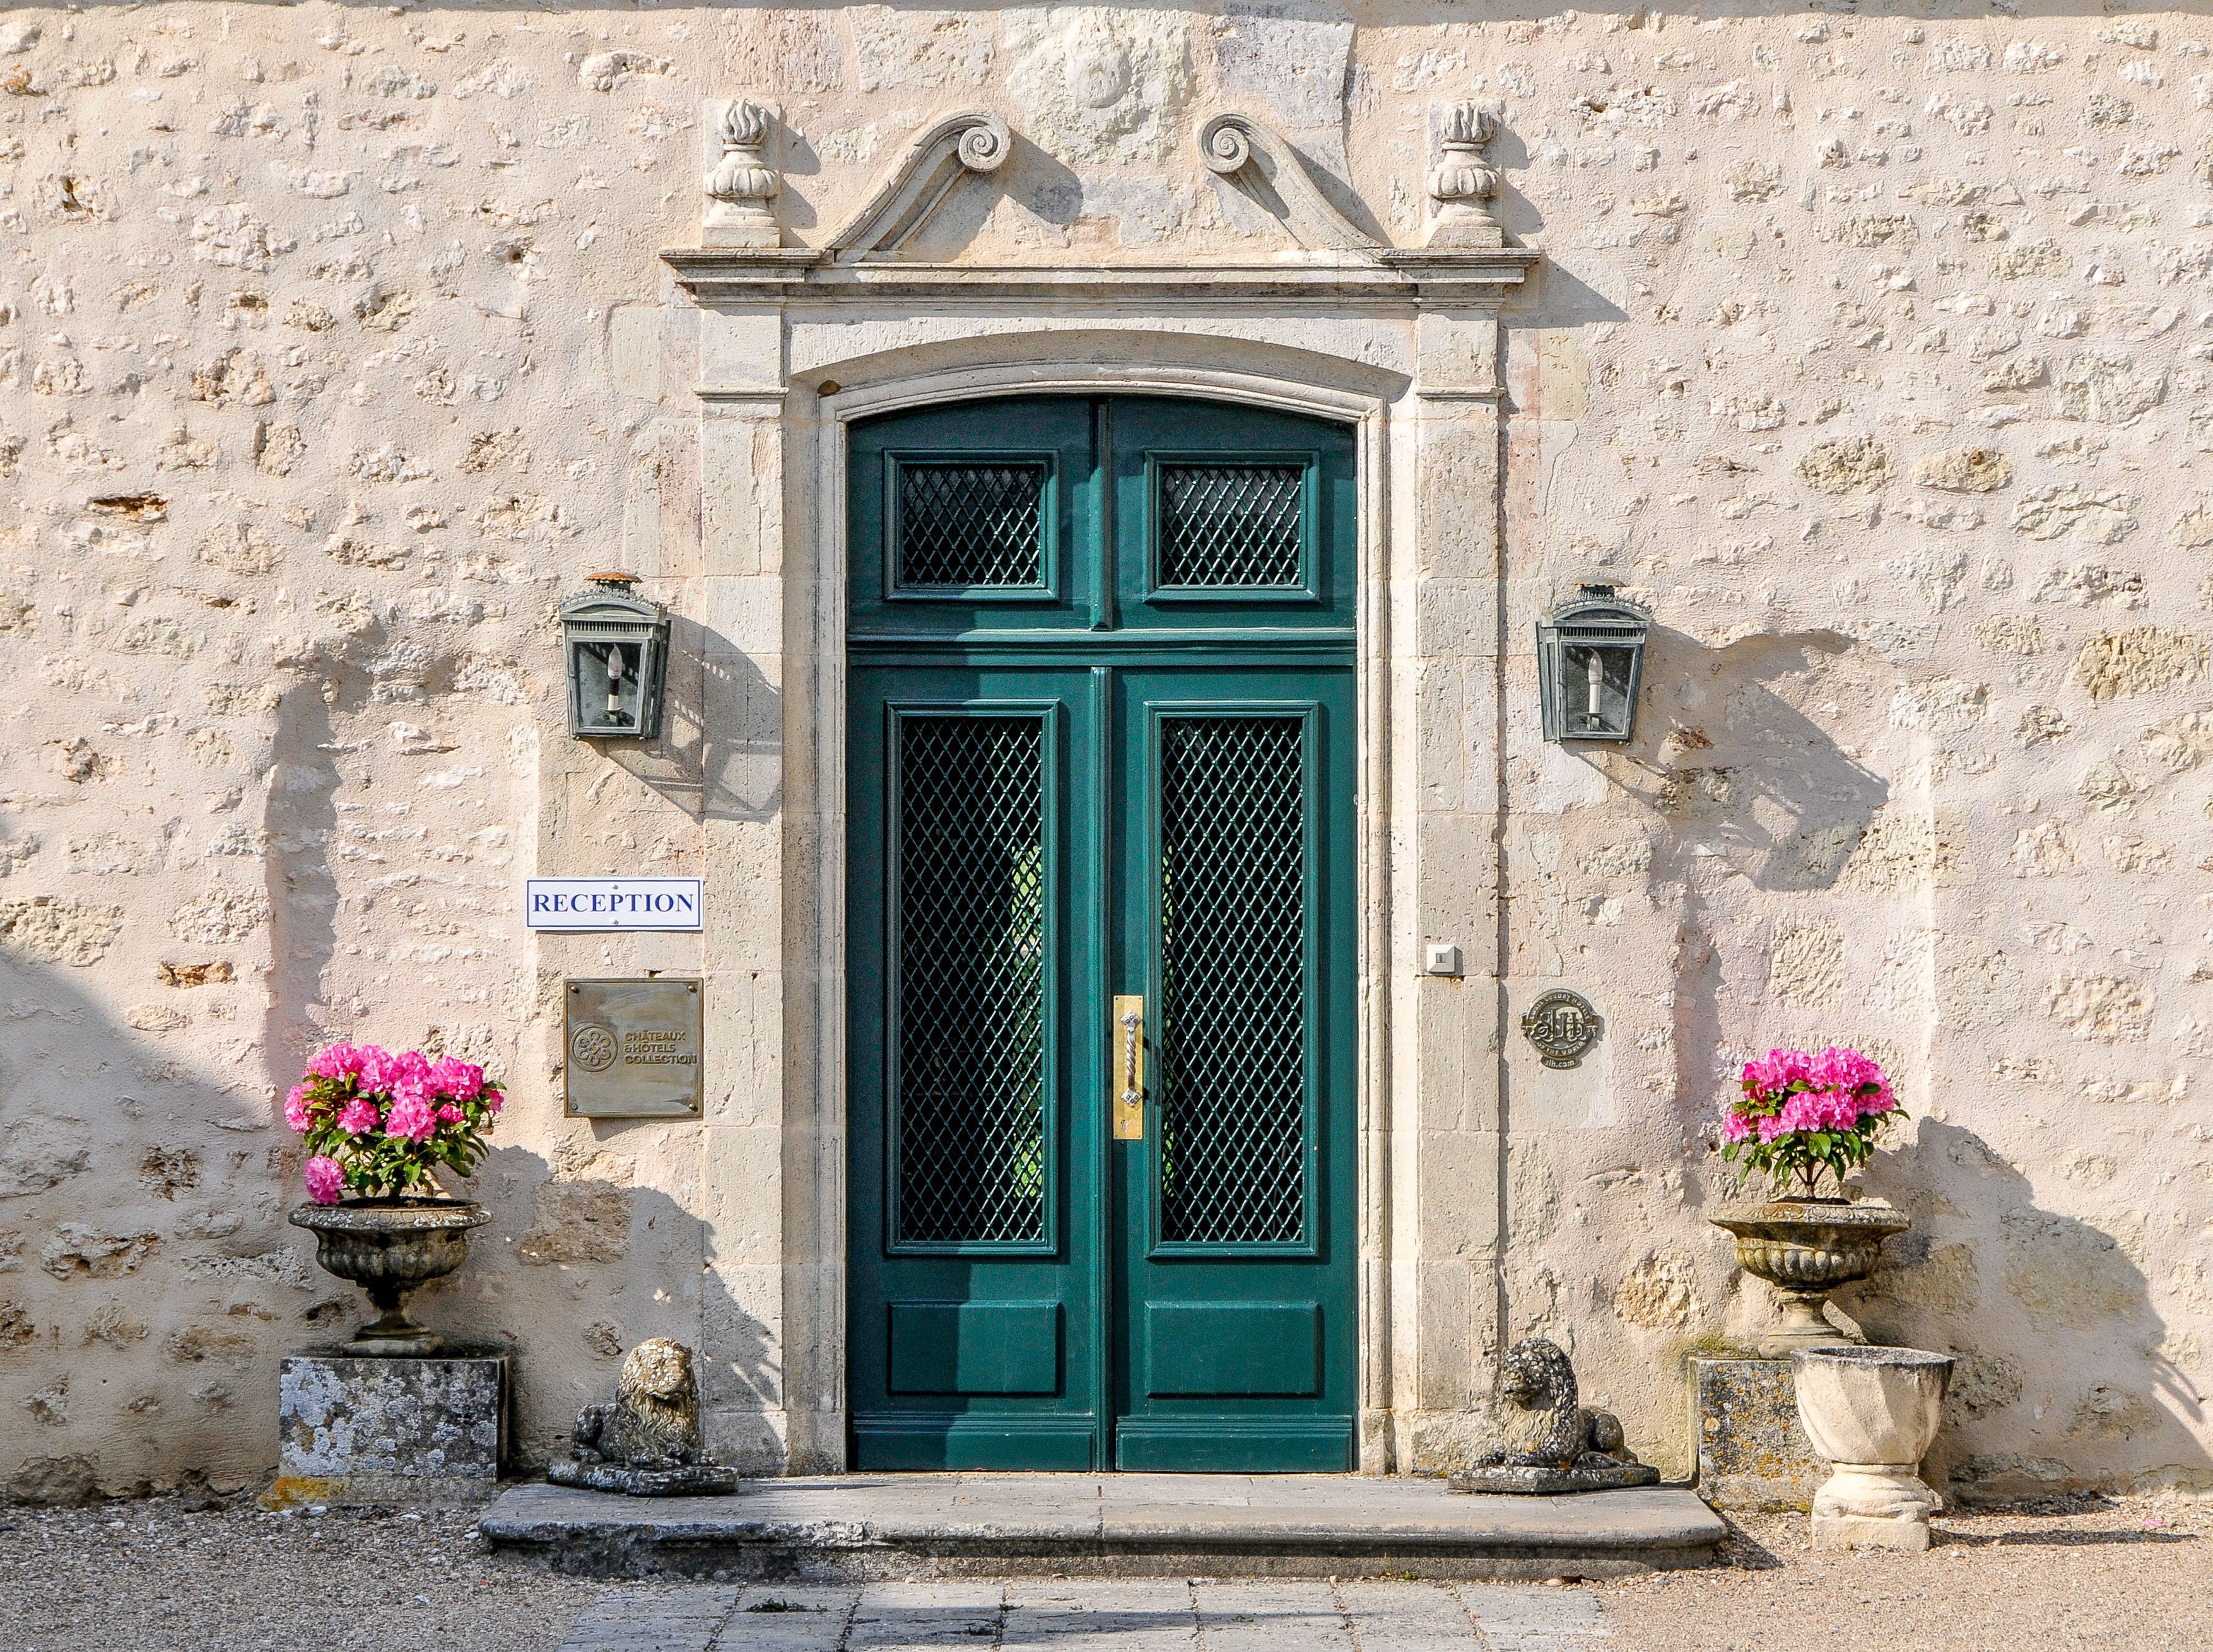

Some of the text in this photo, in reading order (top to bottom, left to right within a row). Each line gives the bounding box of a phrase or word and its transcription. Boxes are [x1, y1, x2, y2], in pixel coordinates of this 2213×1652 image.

[532, 894, 695, 912] RECEPTION
[624, 1054, 698, 1065] COLLECTION
[1544, 1060, 1575, 1068] slh.com
